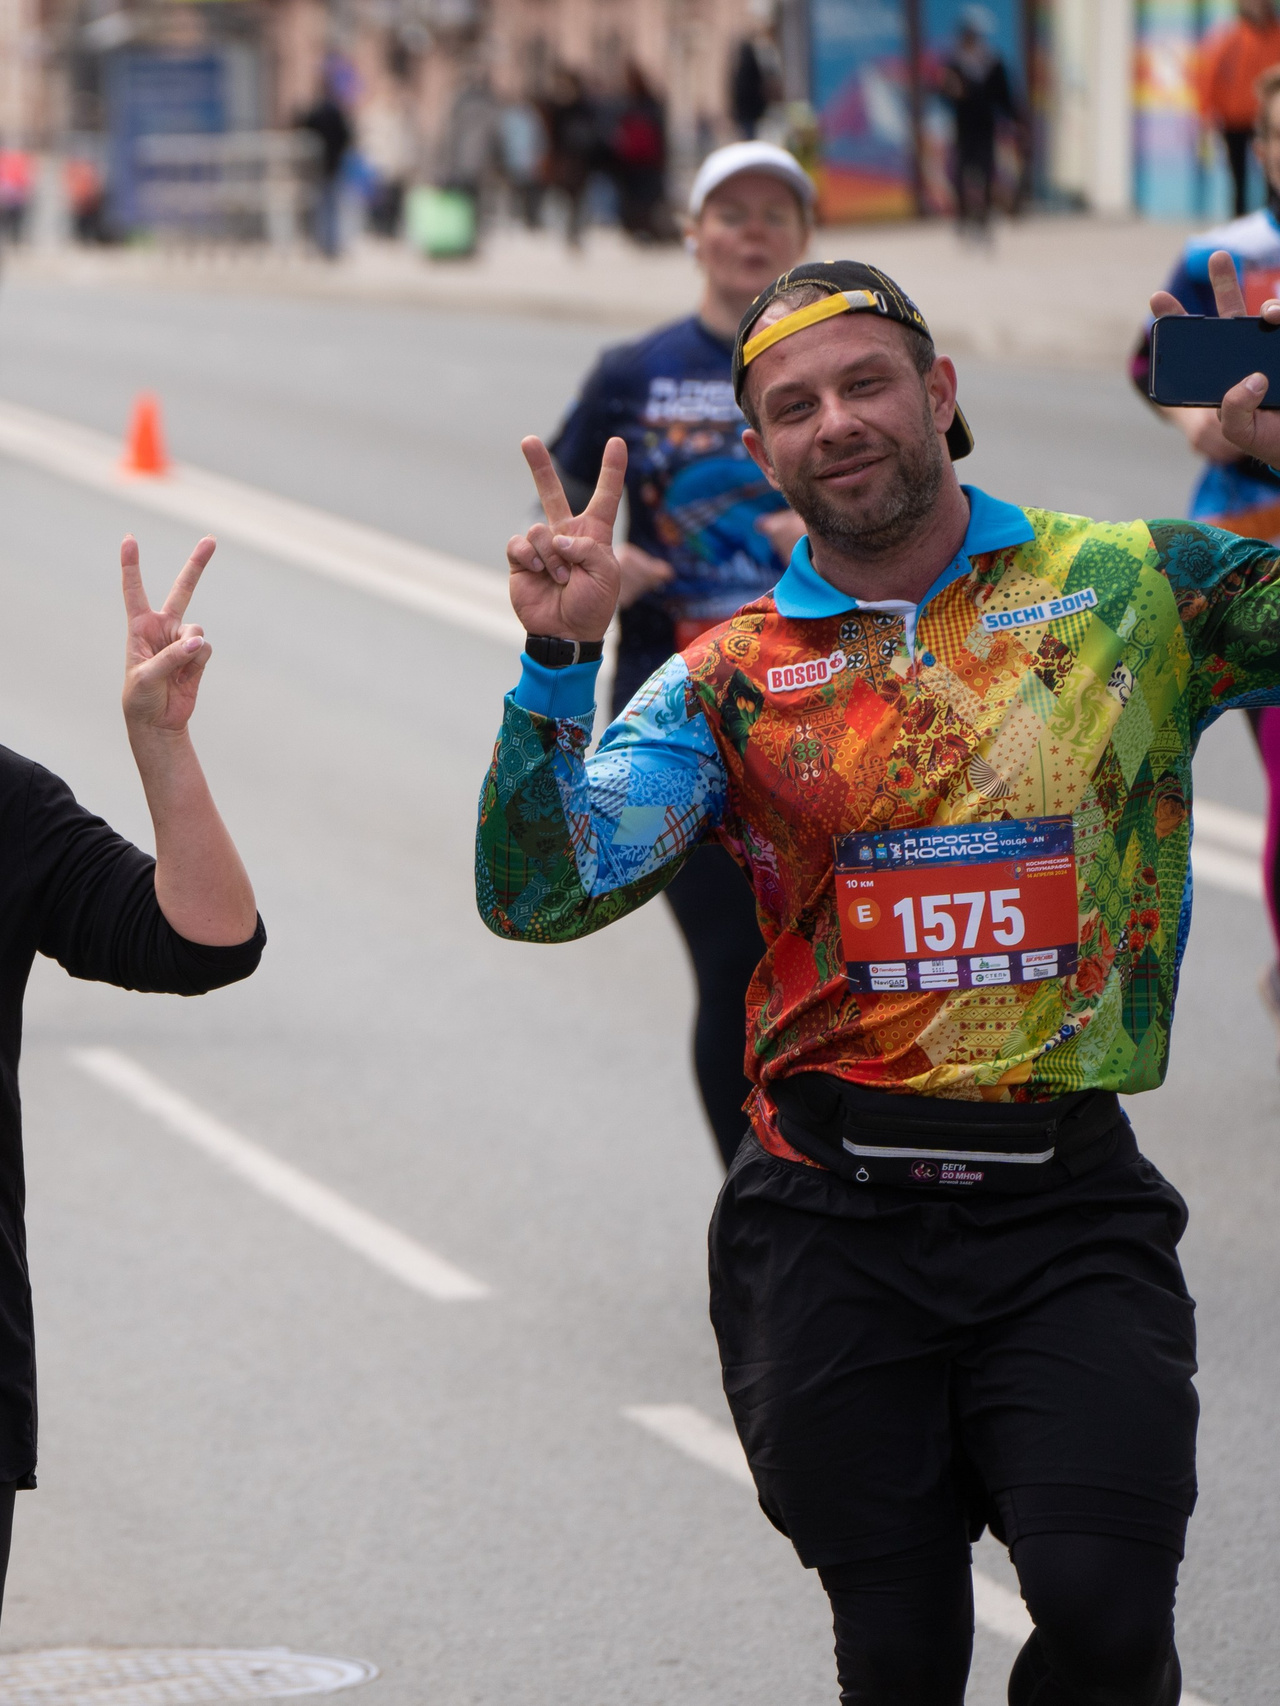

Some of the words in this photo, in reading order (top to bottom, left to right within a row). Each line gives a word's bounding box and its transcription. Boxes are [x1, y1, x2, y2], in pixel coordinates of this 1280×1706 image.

[985, 606, 1045, 629] SOCHI
[1049, 590, 1095, 616] 2014
[771, 661, 828, 689] BOSCO
[903, 838, 917, 848] Я
[919, 831, 998, 847] ПРОСТО
[904, 841, 999, 860] КОСМОС
[846, 879, 858, 889] 10
[893, 888, 1026, 954] 1575
[941, 1163, 967, 1171] БЕГИ
[955, 1172, 983, 1181] МНОЙ
